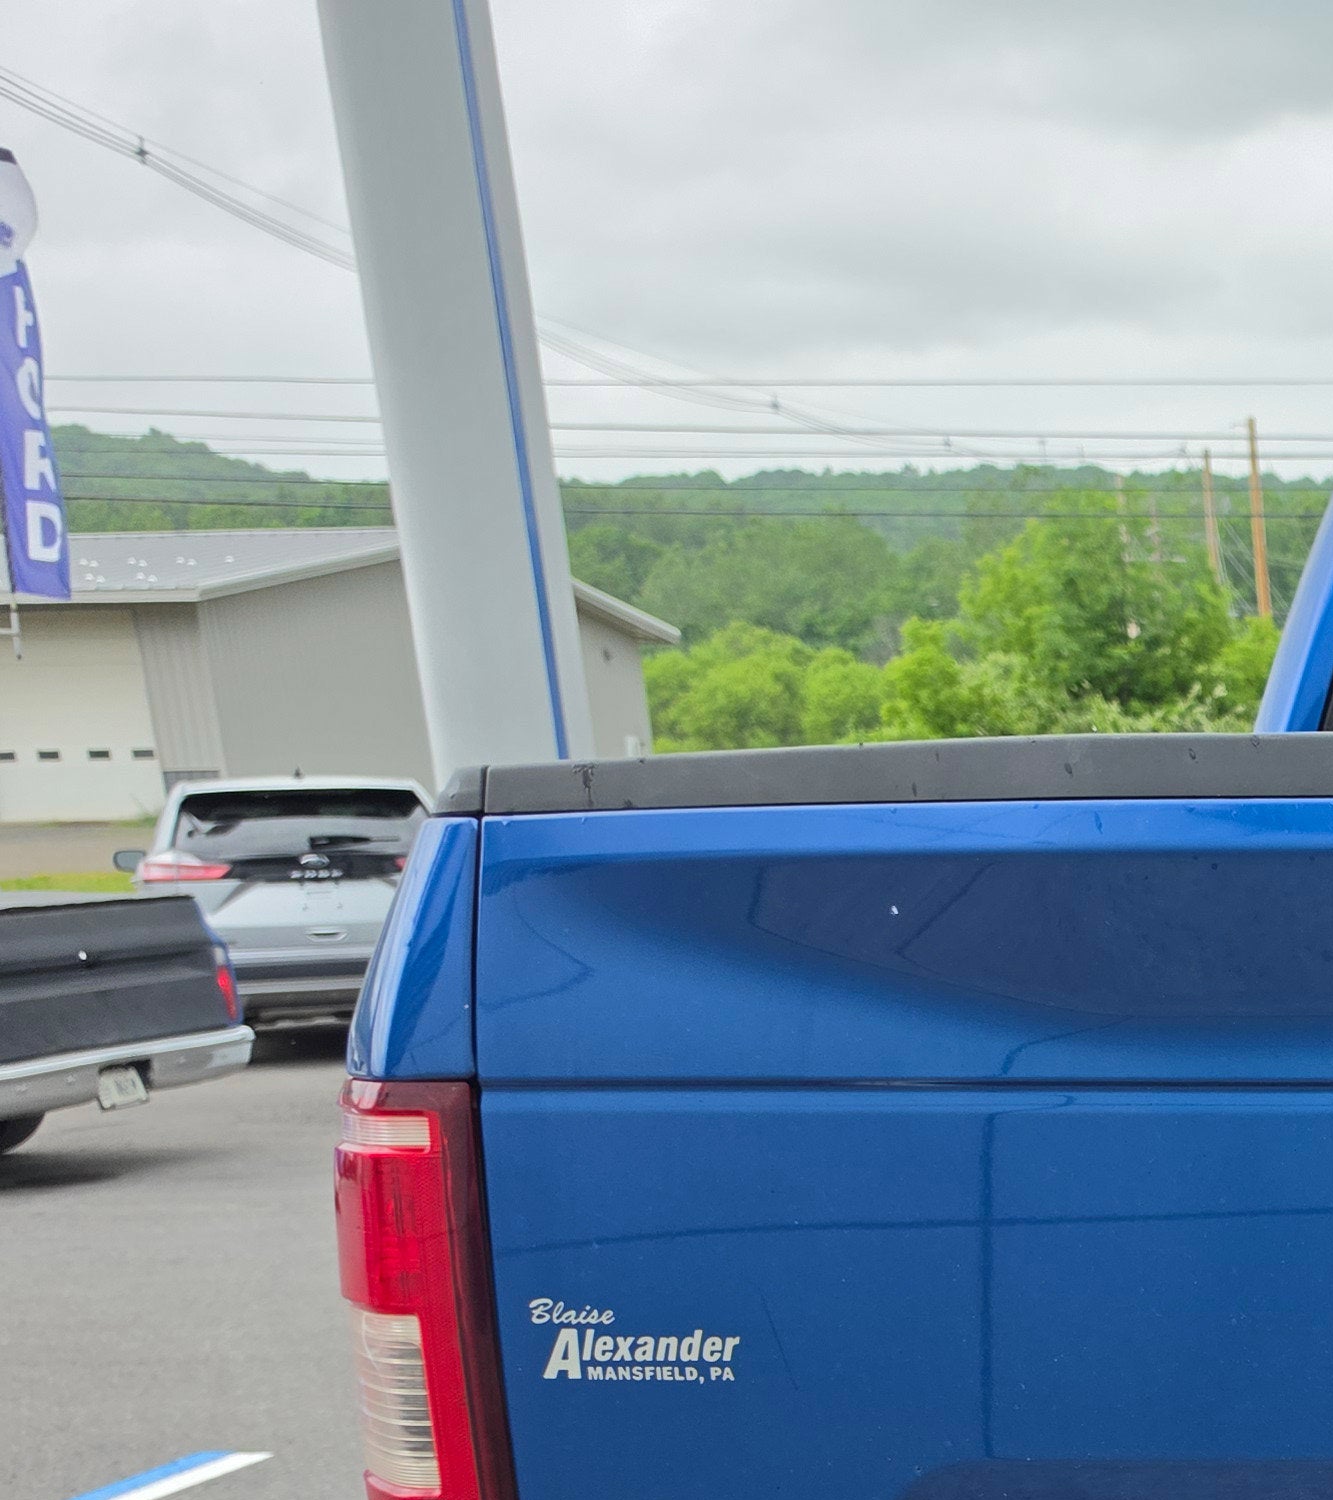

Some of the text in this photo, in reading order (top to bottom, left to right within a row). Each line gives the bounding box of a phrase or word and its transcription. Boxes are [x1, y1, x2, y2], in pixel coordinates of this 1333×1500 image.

[529, 1298, 616, 1325] Blaise
[543, 1328, 741, 1380] Alexander
[587, 1366, 735, 1384] MANSFIELD, PA
